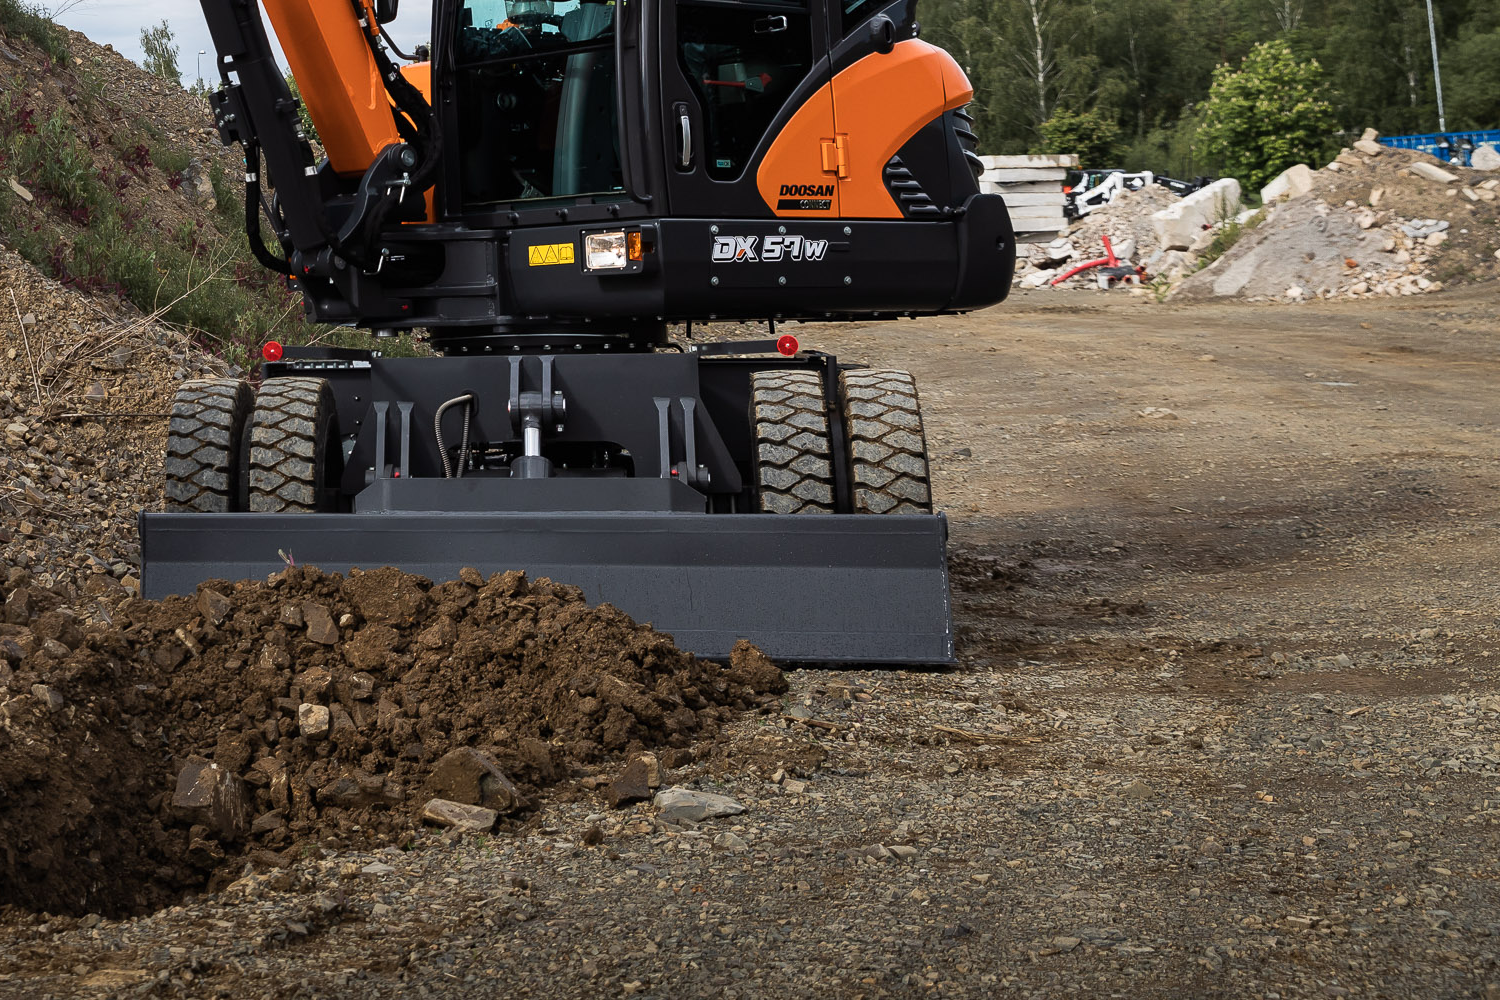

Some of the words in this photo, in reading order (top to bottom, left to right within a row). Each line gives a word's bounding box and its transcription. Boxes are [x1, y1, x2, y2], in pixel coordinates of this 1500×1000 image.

[779, 184, 835, 197] DOOSAN
[800, 199, 831, 209] CONNECT
[712, 235, 759, 262] DX
